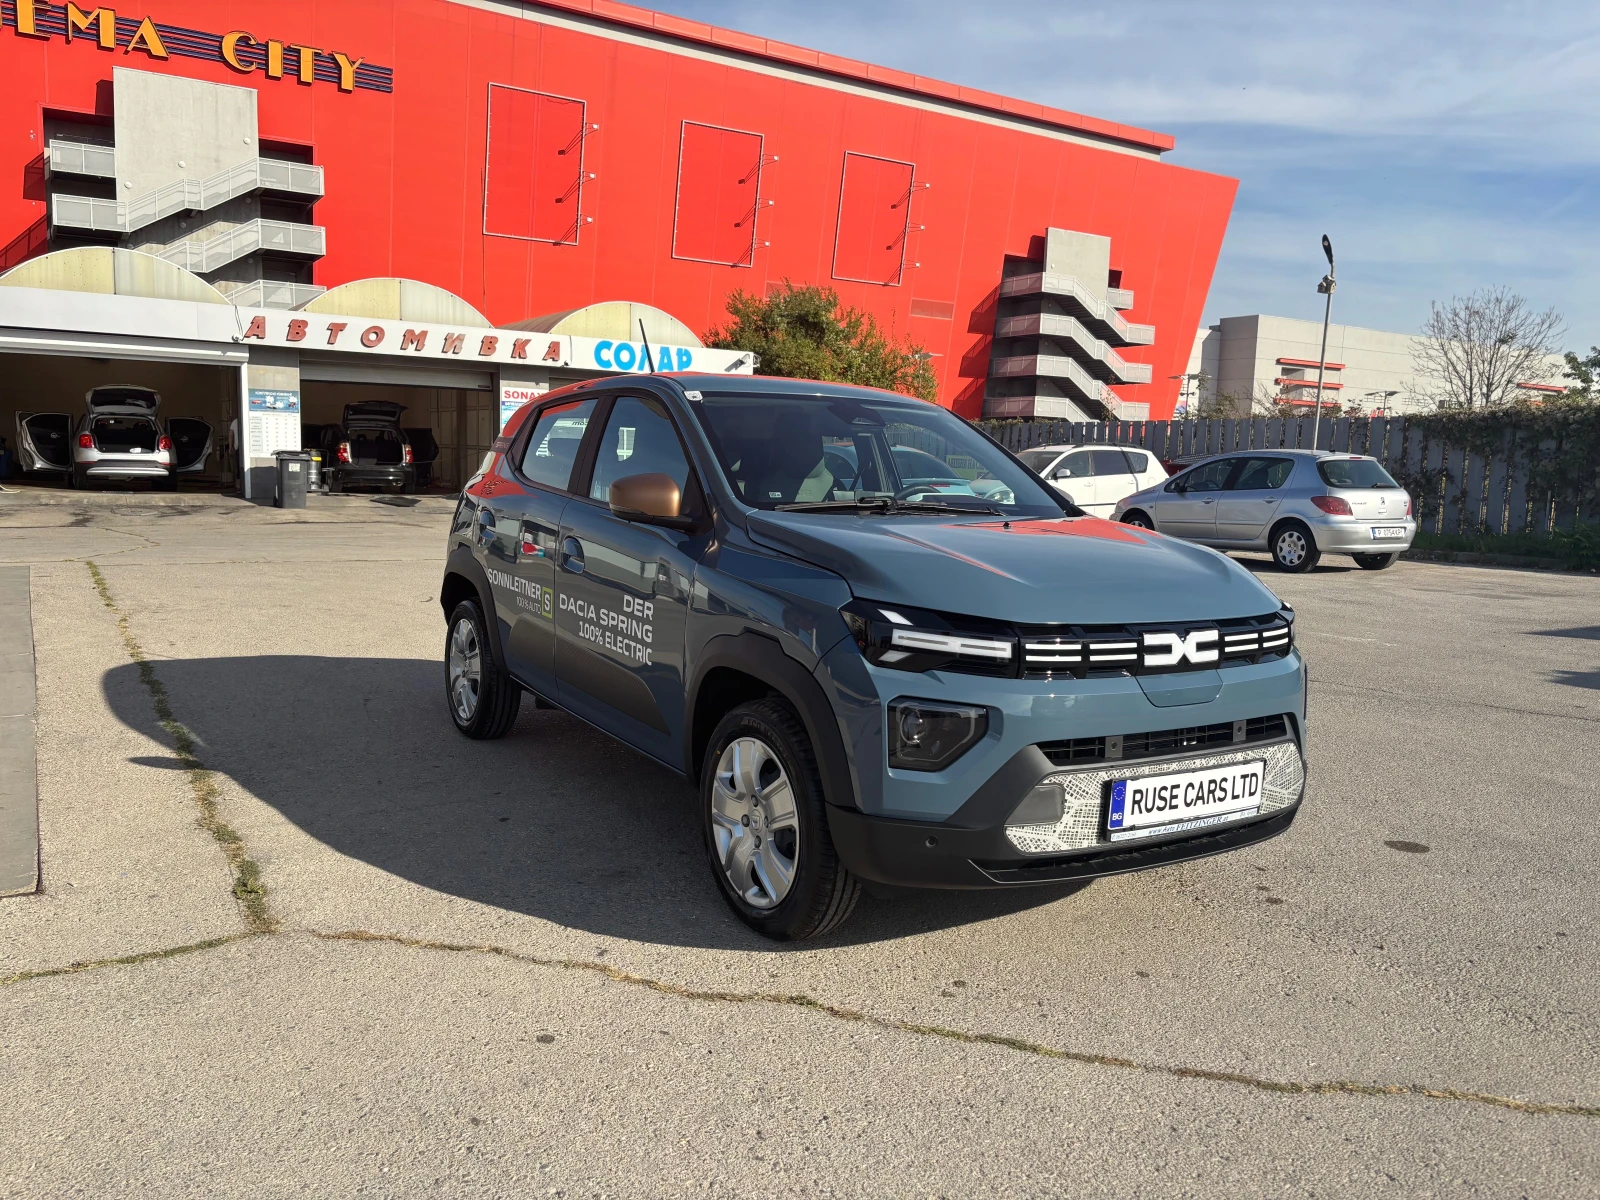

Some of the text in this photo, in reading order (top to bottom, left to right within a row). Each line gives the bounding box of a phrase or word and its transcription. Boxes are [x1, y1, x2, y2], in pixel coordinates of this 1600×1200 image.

[0, 0, 365, 91] EMA CITY
[244, 315, 560, 362] АВТОМИВКА
[487, 568, 541, 600] SONNLEITNER
[559, 593, 653, 643] DACIA SPRING
[623, 594, 654, 621] DER
[579, 621, 653, 666] 100% ELECTRIC
[1131, 772, 1259, 816] RUSE CARS LTD
[1112, 812, 1123, 821] BG
